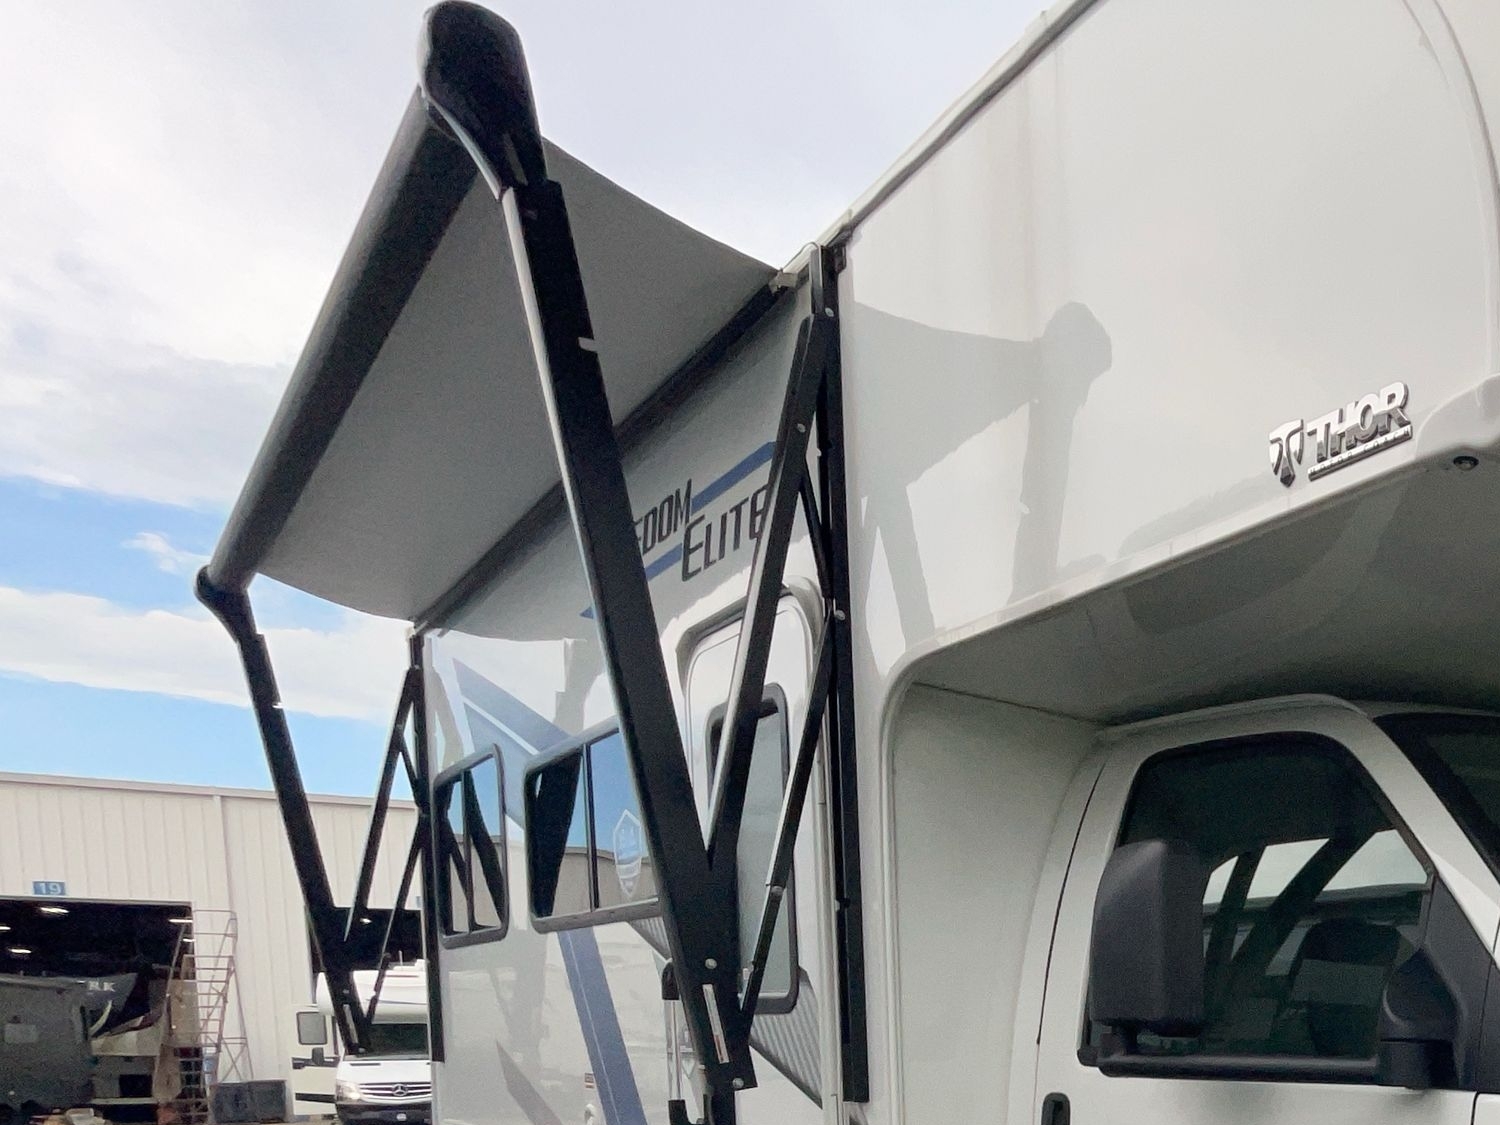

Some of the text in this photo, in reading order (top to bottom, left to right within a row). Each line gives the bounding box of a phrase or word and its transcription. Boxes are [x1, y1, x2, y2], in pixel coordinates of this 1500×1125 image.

[1306, 382, 1411, 463] THOR
[681, 484, 769, 582] ELITE
[40, 882, 61, 896] 19
